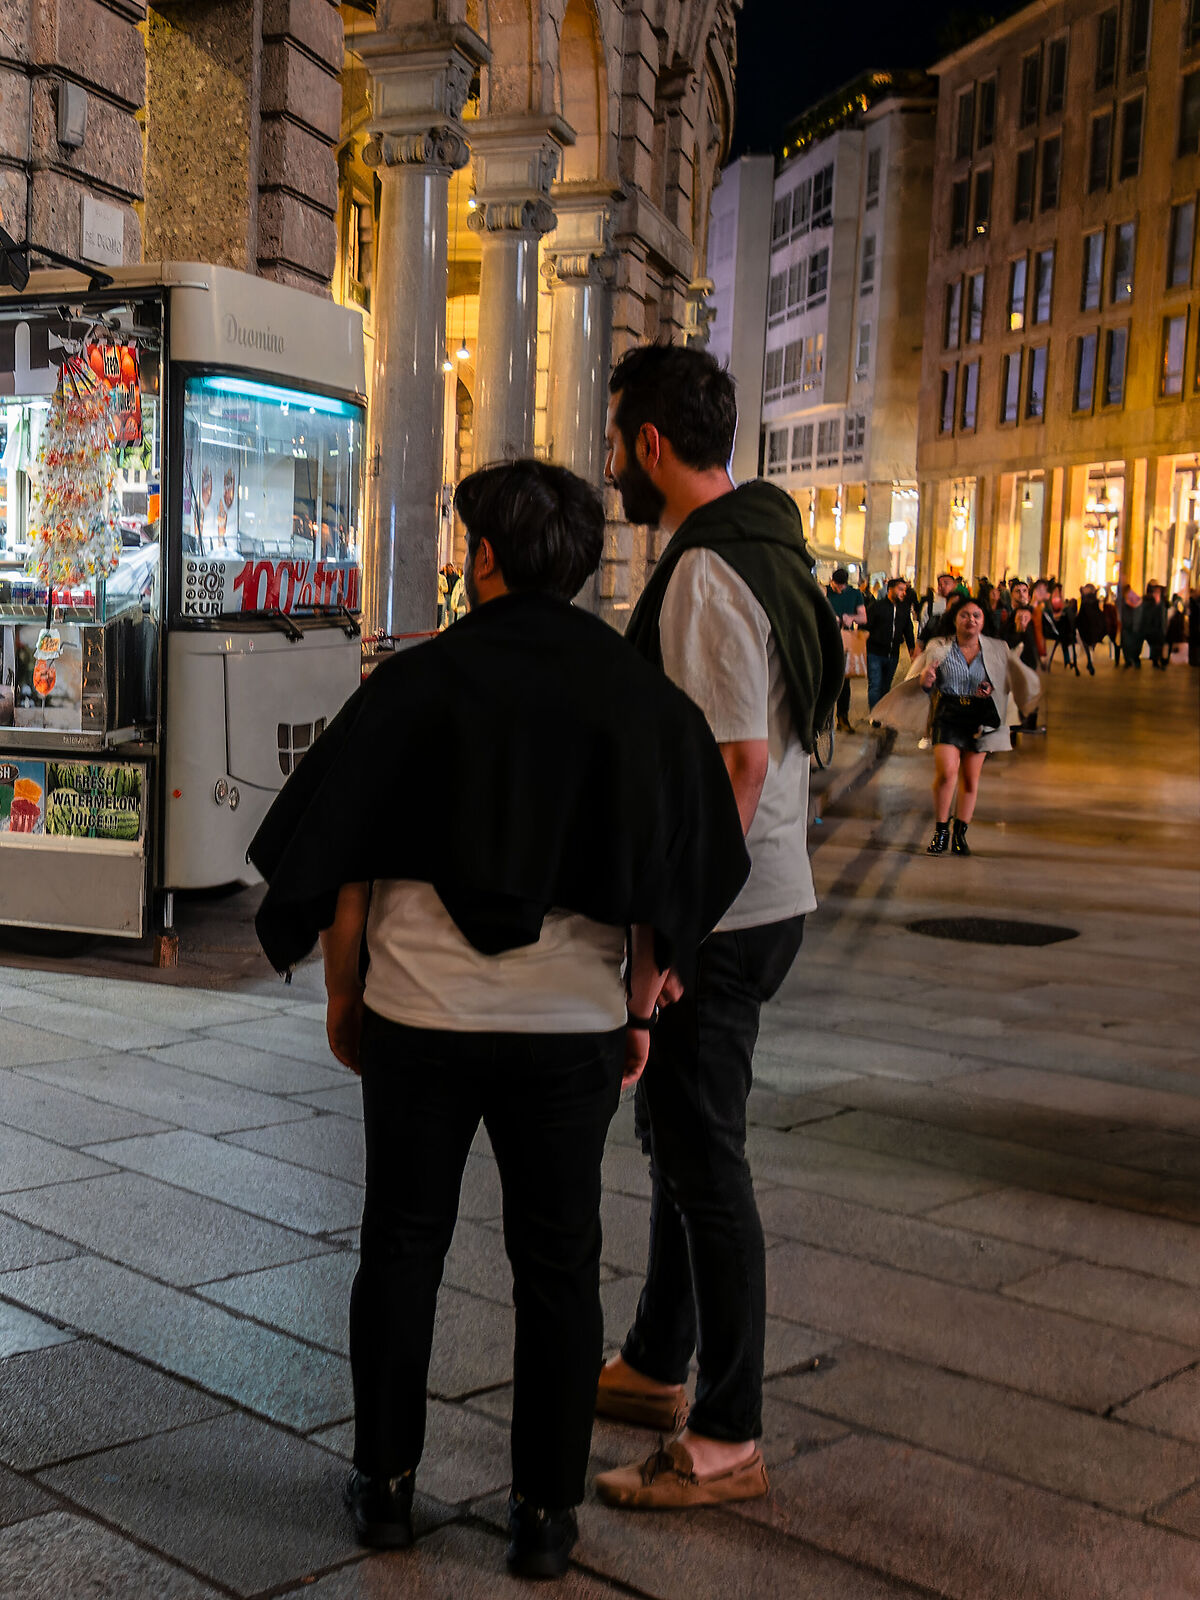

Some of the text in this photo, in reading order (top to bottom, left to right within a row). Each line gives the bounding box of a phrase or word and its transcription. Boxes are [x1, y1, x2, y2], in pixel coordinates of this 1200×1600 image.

[225, 313, 285, 354] Duomino
[184, 601, 224, 615] KURI
[75, 773, 115, 791] FRESH
[52, 791, 138, 811] WATERMELON
